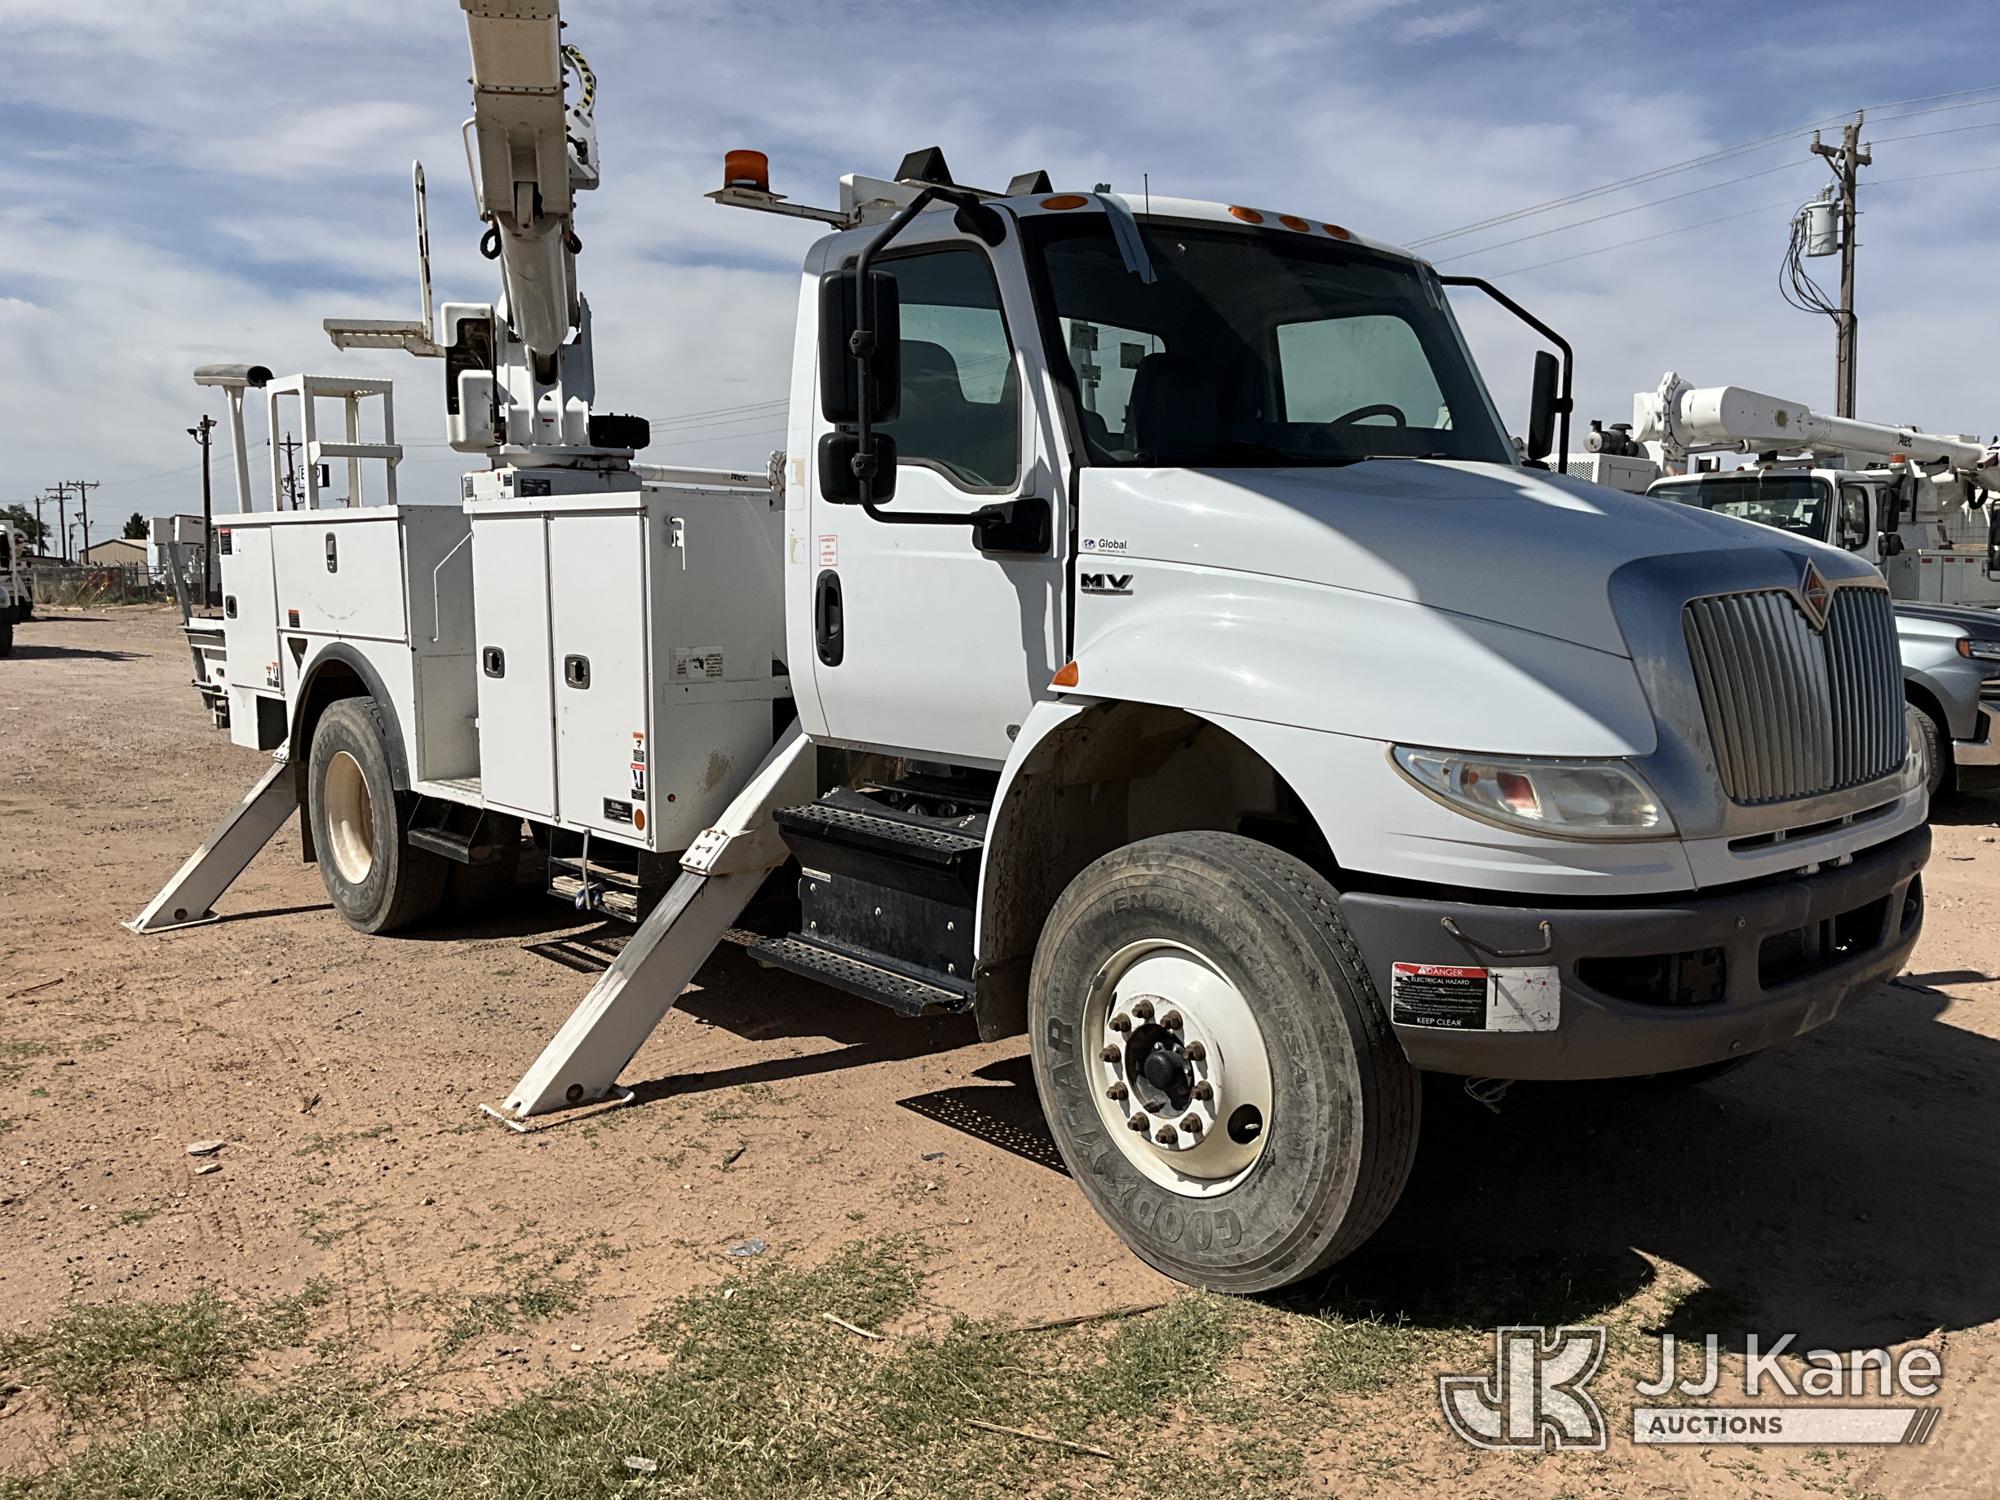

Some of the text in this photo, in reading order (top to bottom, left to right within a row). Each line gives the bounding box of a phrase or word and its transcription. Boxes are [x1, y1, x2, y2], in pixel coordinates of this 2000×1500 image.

[1098, 538, 1127, 549] Global
[1080, 573, 1133, 589] MV
[1426, 967, 1463, 977] DANGER
[1411, 977, 1445, 985] ELECTRICAL
[1416, 1017, 1462, 1027] KEEP CLEAR
